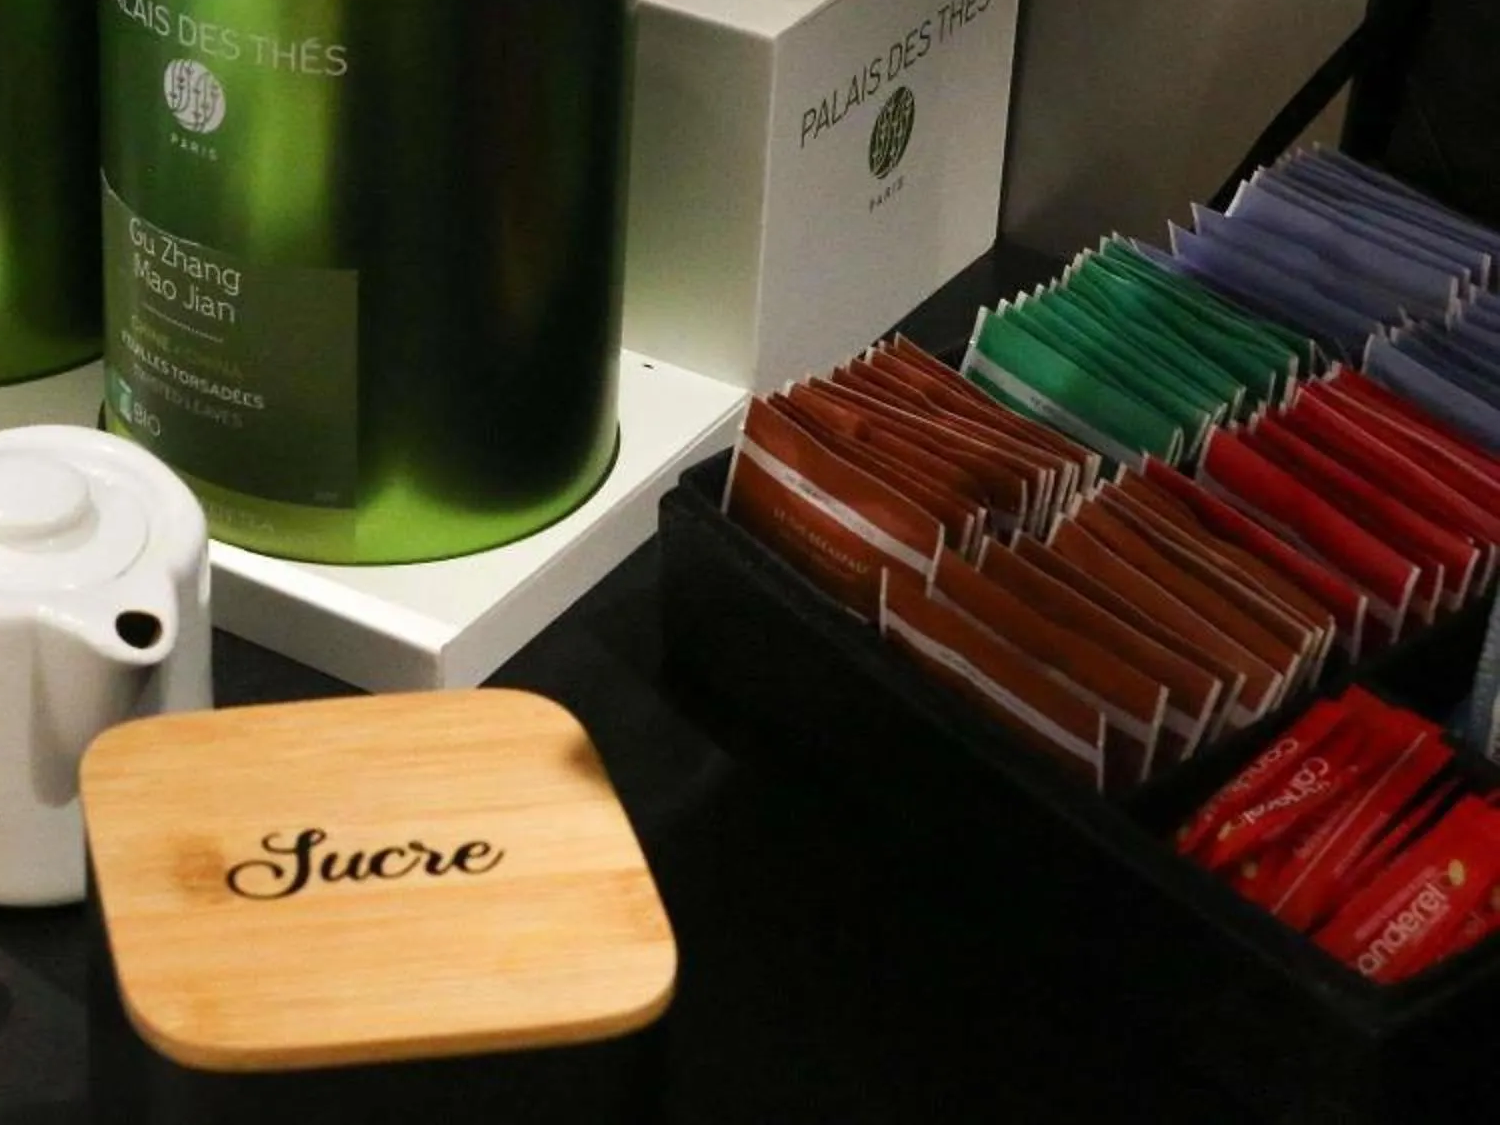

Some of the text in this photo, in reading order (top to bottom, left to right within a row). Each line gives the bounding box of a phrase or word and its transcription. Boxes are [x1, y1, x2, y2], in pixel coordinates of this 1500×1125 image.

[178, 13, 242, 61] DES
[248, 35, 349, 77] THÉS
[800, 57, 884, 150] PALAIS
[887, 19, 933, 83] DES
[128, 216, 242, 297] Gu Zhang
[133, 251, 236, 324] Mao Jian
[226, 827, 505, 901] Sucre
[1355, 881, 1449, 977] anderel
